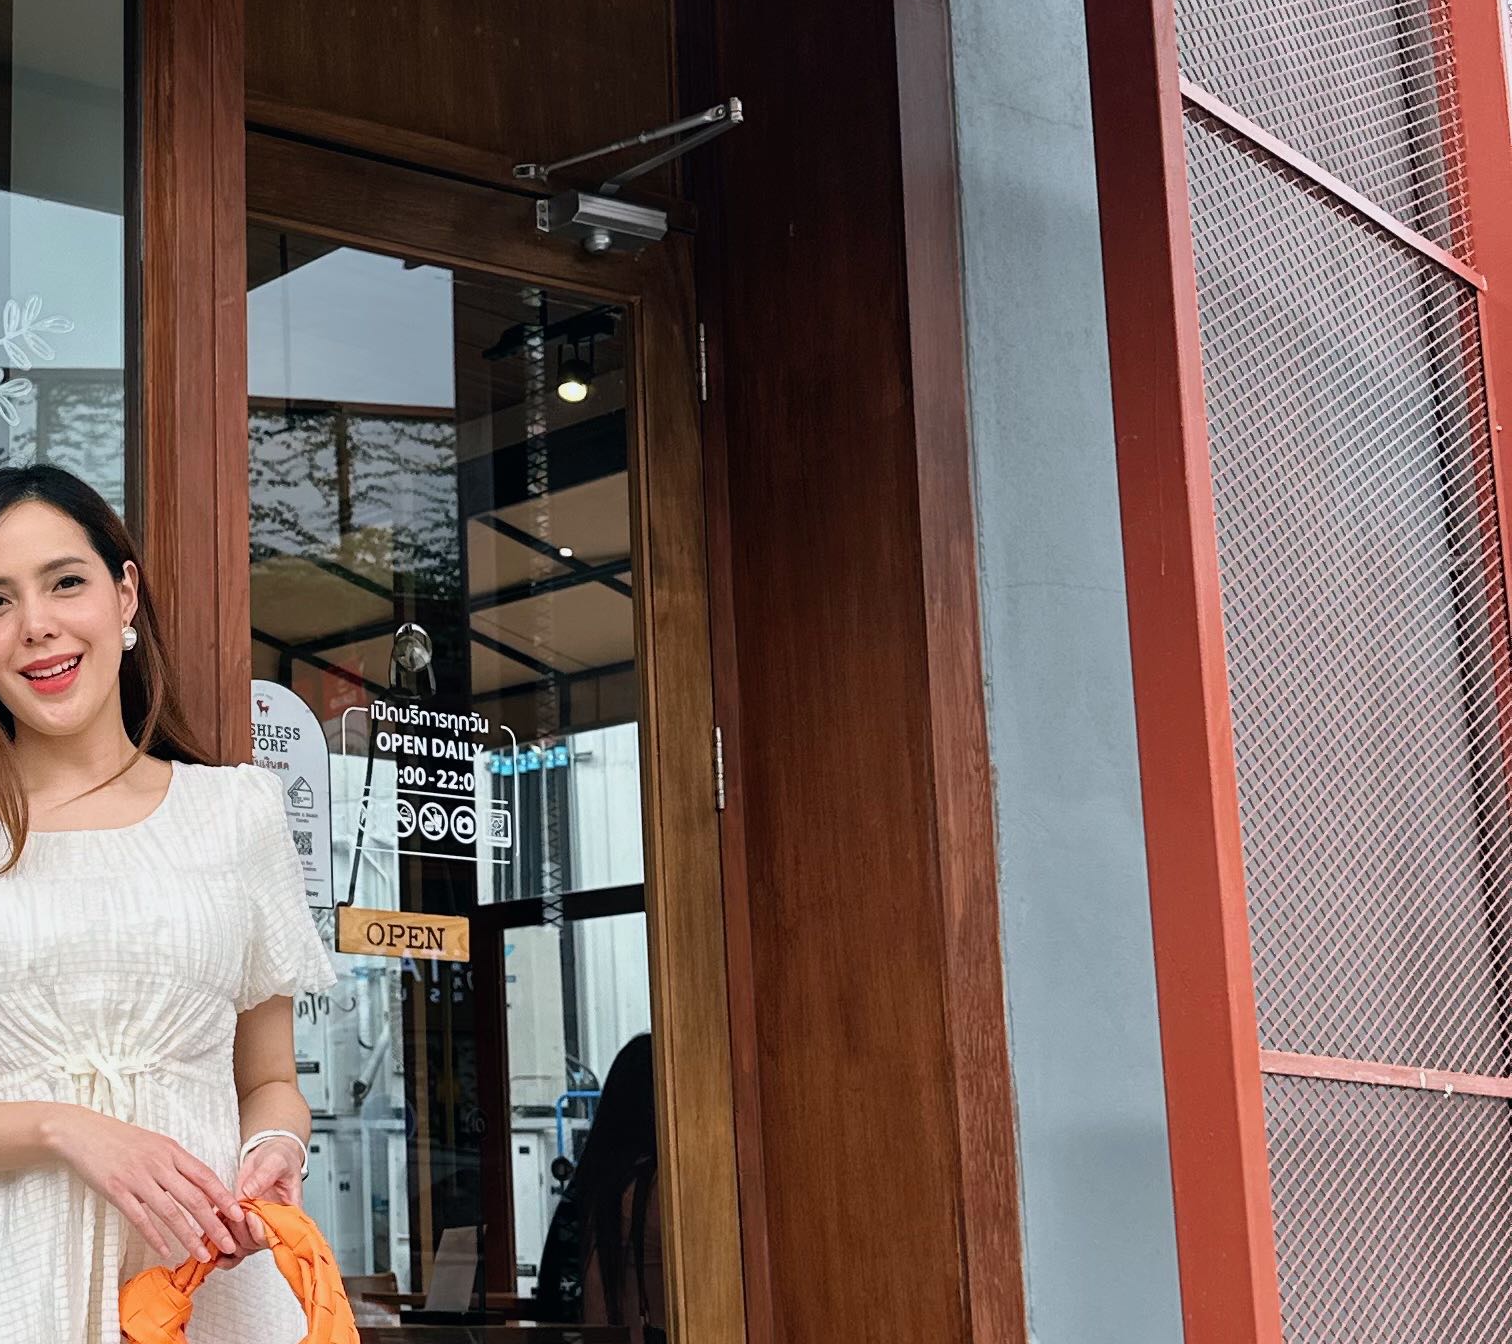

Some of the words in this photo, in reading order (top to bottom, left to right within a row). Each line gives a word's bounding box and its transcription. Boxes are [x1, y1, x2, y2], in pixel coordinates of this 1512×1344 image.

[370, 700, 489, 737] เปิดบริการทุกวัน
[376, 731, 428, 756] OPEN
[431, 737, 484, 762] DAILY
[365, 922, 446, 952] OPEN
